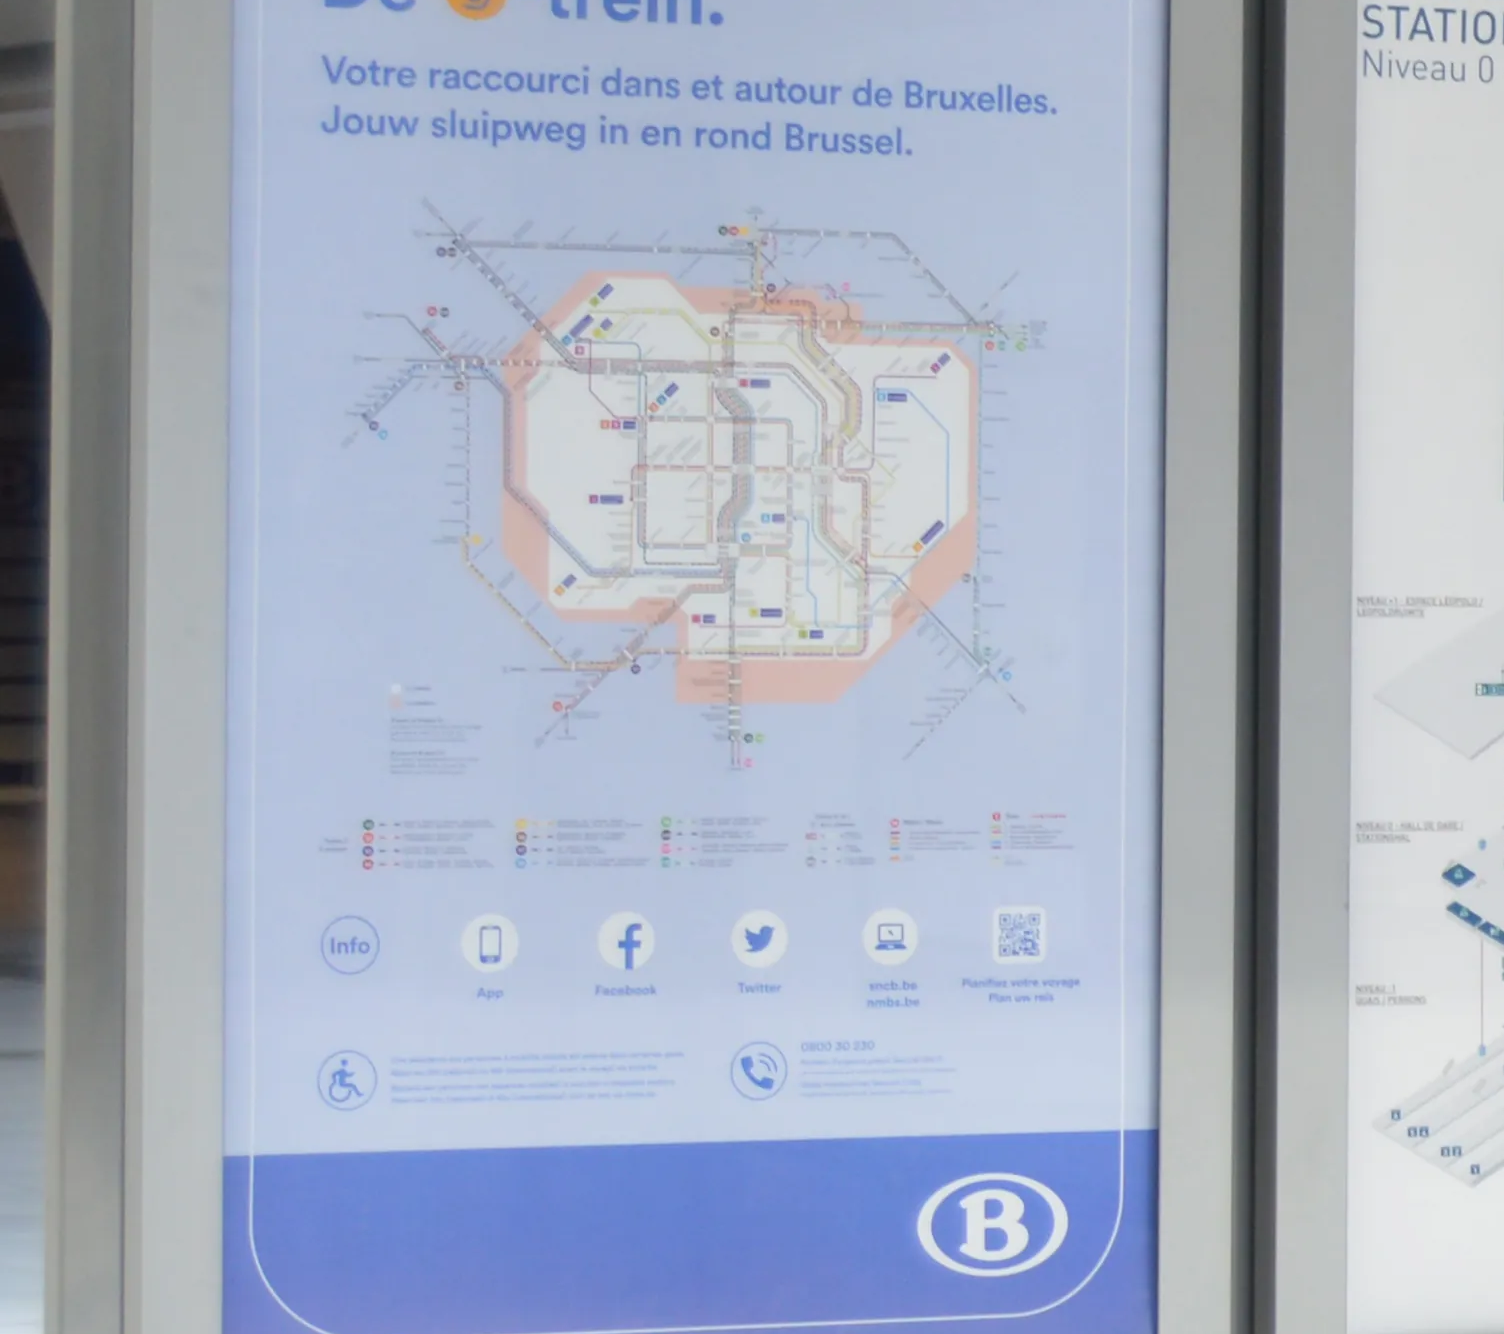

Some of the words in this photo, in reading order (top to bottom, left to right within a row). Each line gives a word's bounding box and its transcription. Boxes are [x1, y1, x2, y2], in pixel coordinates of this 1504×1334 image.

[1362, 49, 1467, 83] Niveau
[1478, 55, 1495, 83] 0
[321, 55, 417, 88] Votre
[429, 65, 590, 95] raccourci
[601, 68, 681, 99] dans
[691, 75, 723, 101] et
[735, 77, 842, 106] autour
[853, 79, 893, 107] de
[904, 80, 1058, 115] Bruxelles.
[321, 104, 419, 137] Jouw
[431, 109, 586, 151] sluipweg
[600, 116, 629, 145] in
[641, 123, 682, 147] en
[695, 122, 771, 150] rond
[784, 123, 913, 156] Brussel.
[329, 936, 371, 955] Info
[594, 984, 657, 997] Facebook
[737, 981, 782, 994] Twitter
[868, 978, 918, 992] sncb.be
[1009, 978, 1040, 989] votre
[1041, 977, 1081, 991] voyage
[476, 987, 504, 1001] App
[988, 992, 1012, 1004] Plan
[866, 994, 920, 1009] nmbs.be
[835, 1041, 850, 1052] 30
